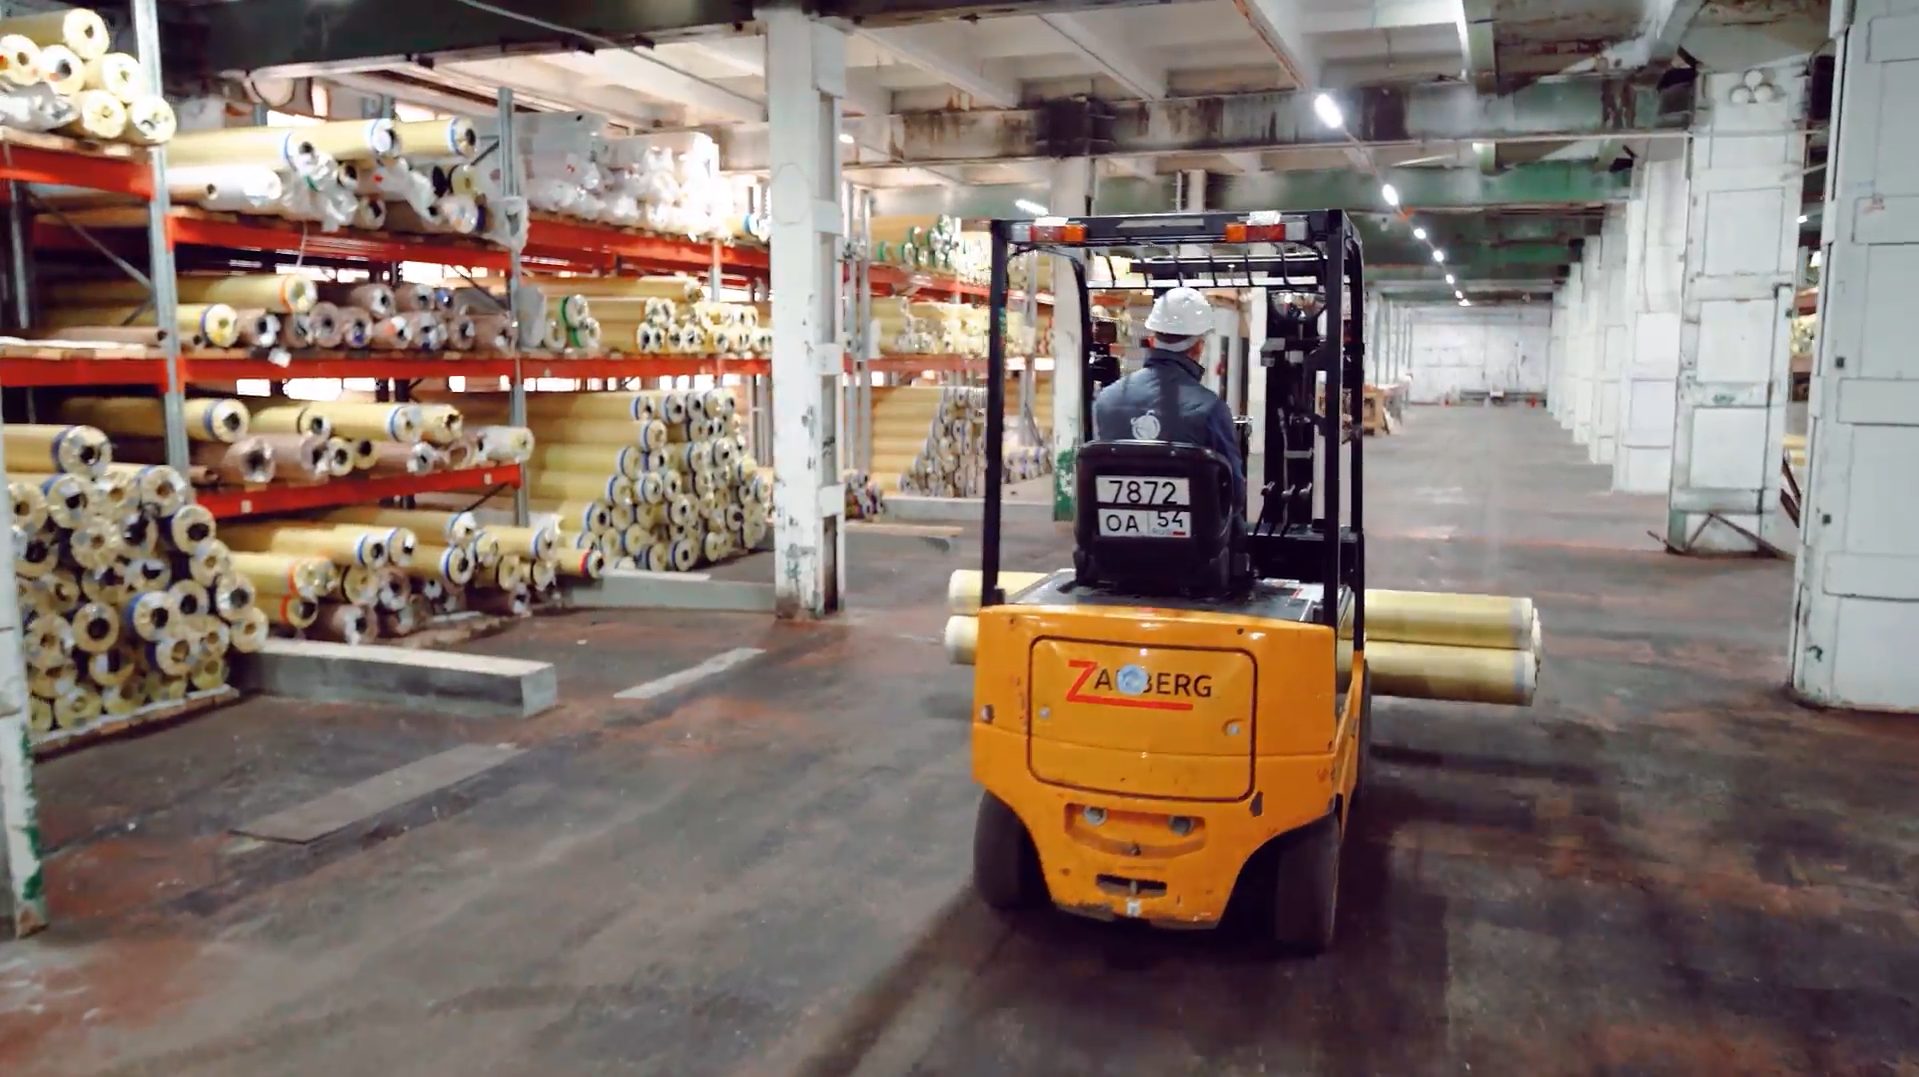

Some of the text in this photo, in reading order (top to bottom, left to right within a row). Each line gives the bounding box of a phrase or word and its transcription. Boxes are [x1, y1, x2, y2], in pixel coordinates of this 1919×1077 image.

[1108, 480, 1178, 505] 7872
[1105, 513, 1140, 533] OA
[1157, 510, 1184, 528] 54
[1066, 659, 1213, 709] ZABERG
